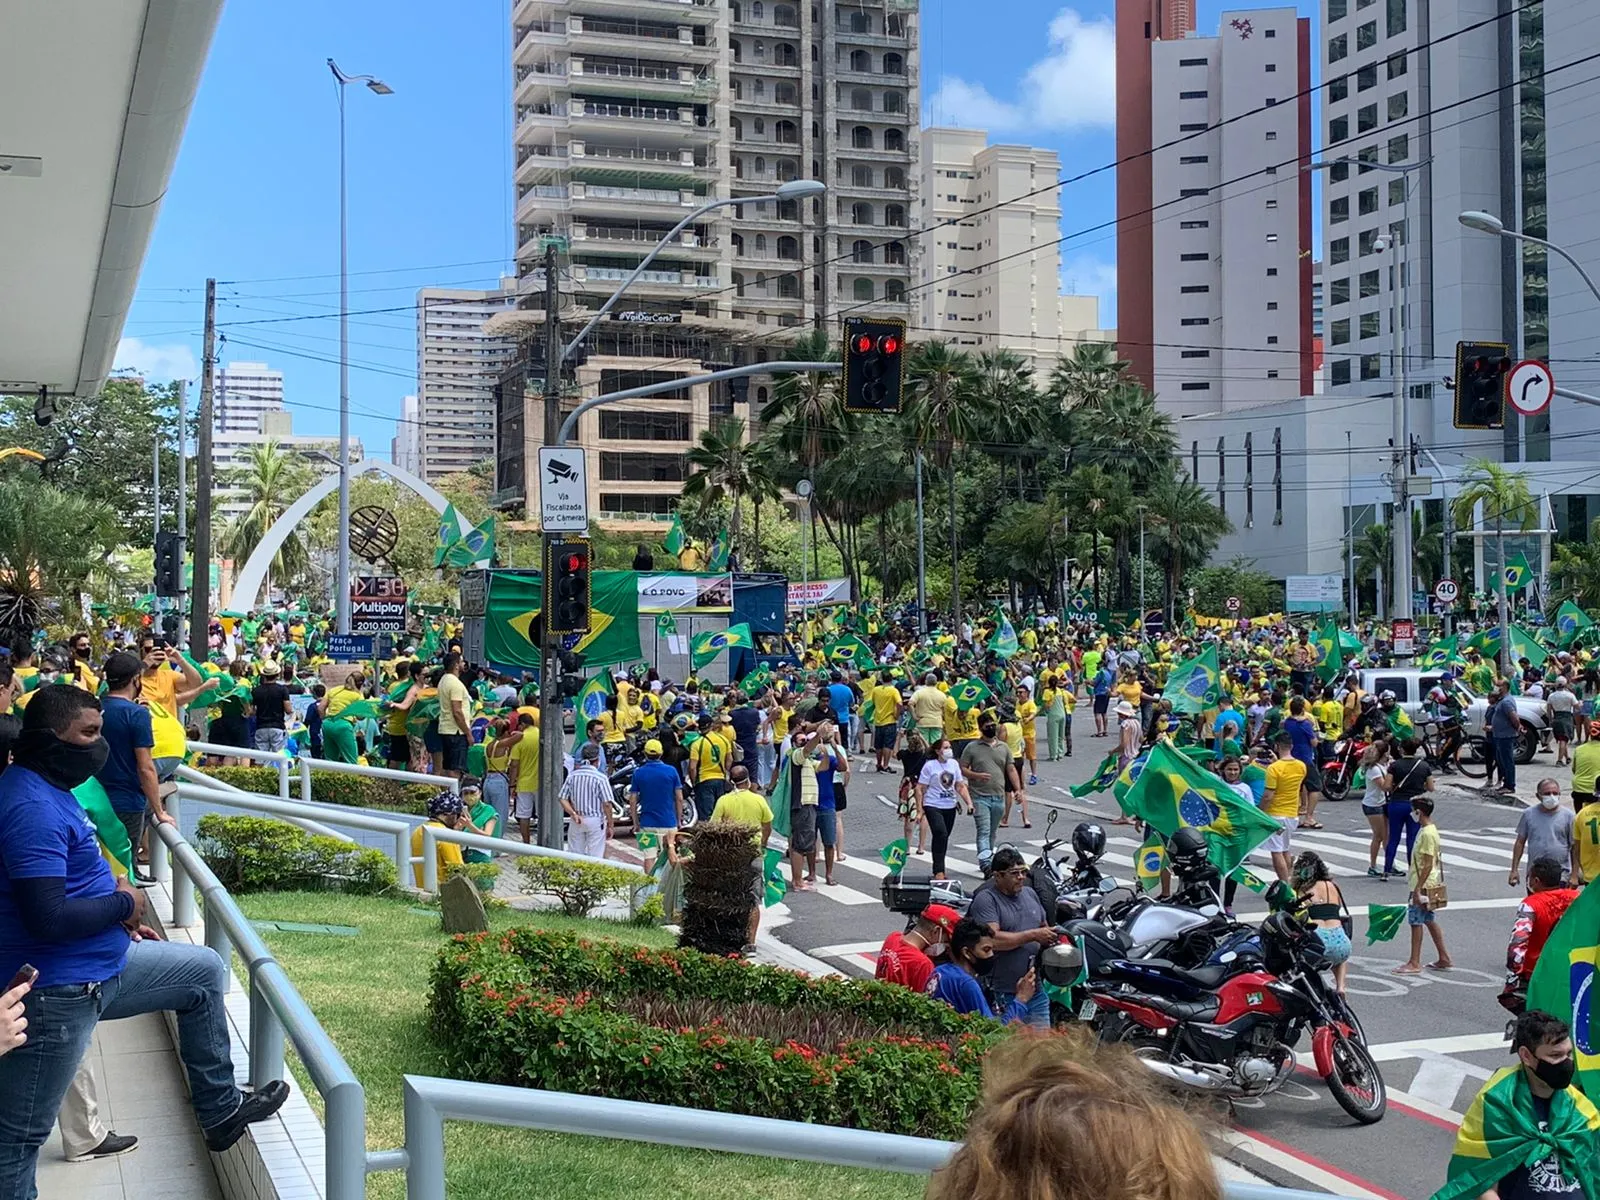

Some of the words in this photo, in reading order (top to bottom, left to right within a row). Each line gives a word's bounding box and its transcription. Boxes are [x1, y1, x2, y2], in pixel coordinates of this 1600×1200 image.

[618, 313, 674, 323] #VaiDarCerto
[558, 492, 569, 500] Via
[546, 503, 582, 511] Fiscalizada
[660, 588, 686, 596] POVO
[1438, 583, 1456, 594] 40
[353, 601, 404, 615] Multiplay
[329, 637, 352, 645] Praça
